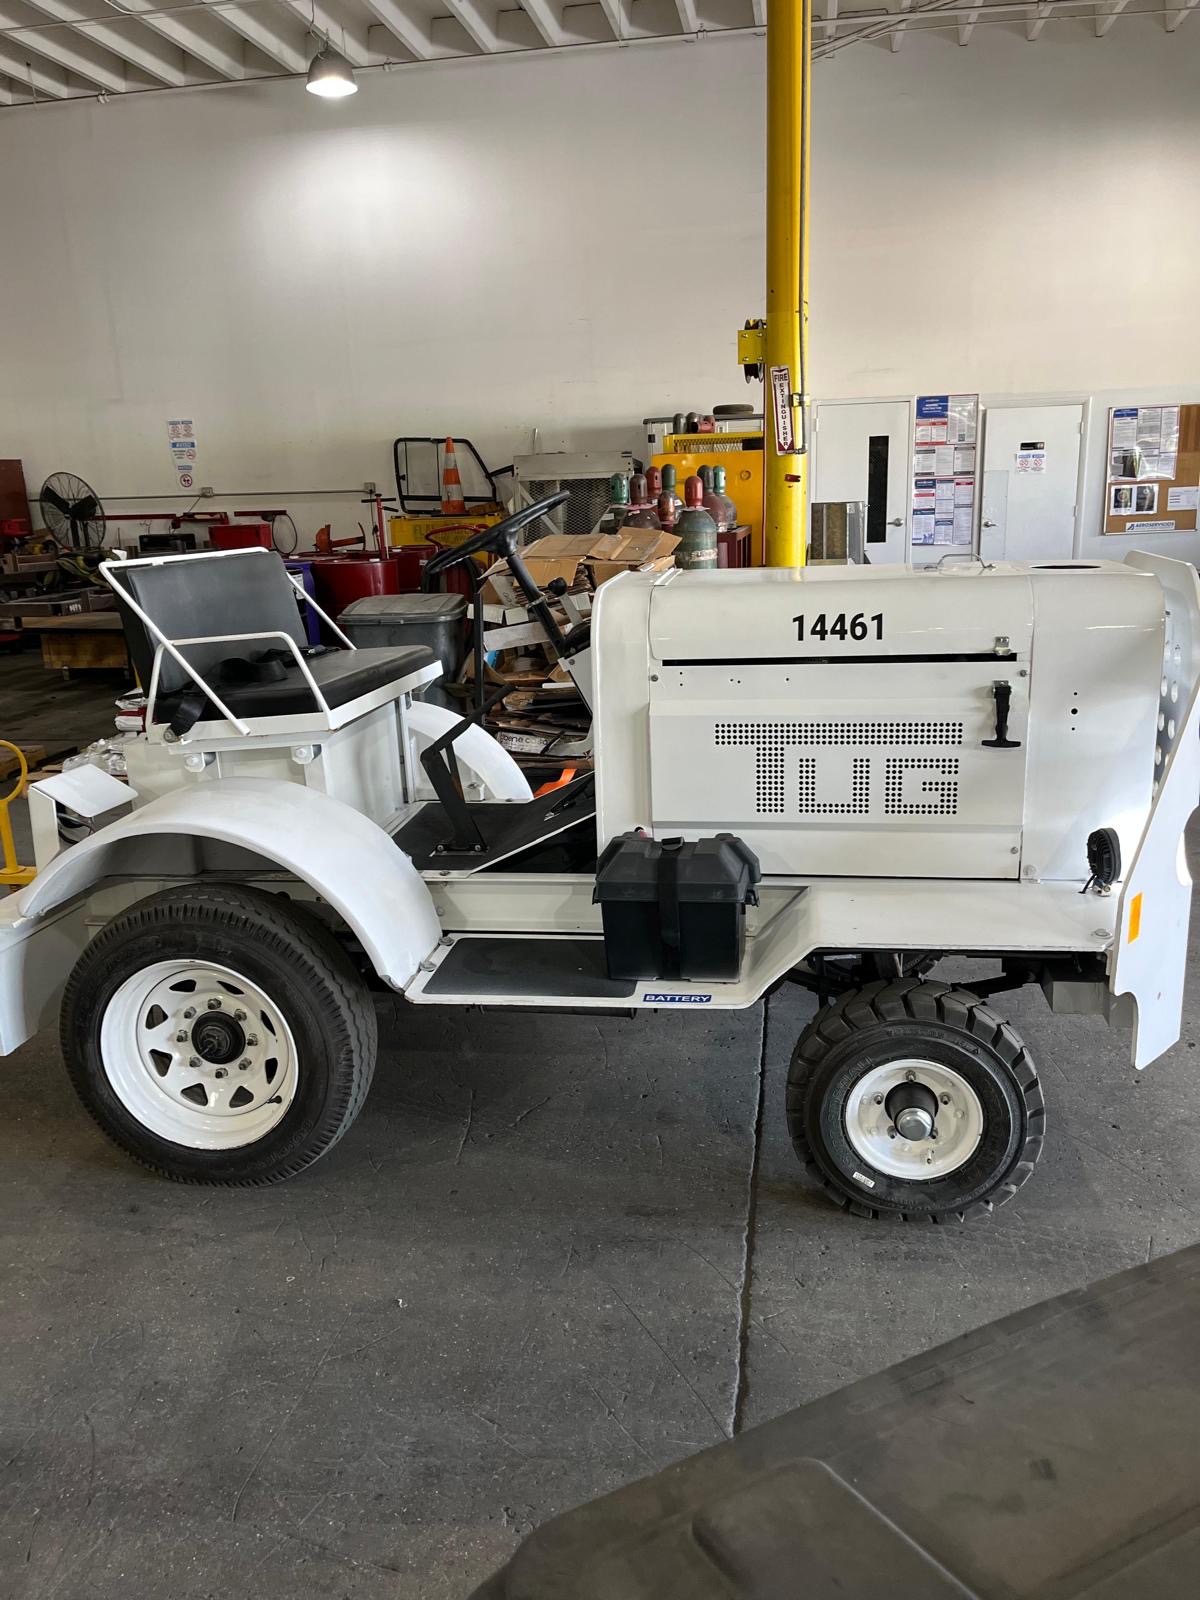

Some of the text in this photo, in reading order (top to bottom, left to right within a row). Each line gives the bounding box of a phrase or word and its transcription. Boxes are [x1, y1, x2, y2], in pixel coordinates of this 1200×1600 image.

[773, 373, 788, 382] FIRE
[779, 383, 788, 447] EXTINGUISHER
[792, 613, 883, 641] 14461
[715, 722, 963, 815] TUG
